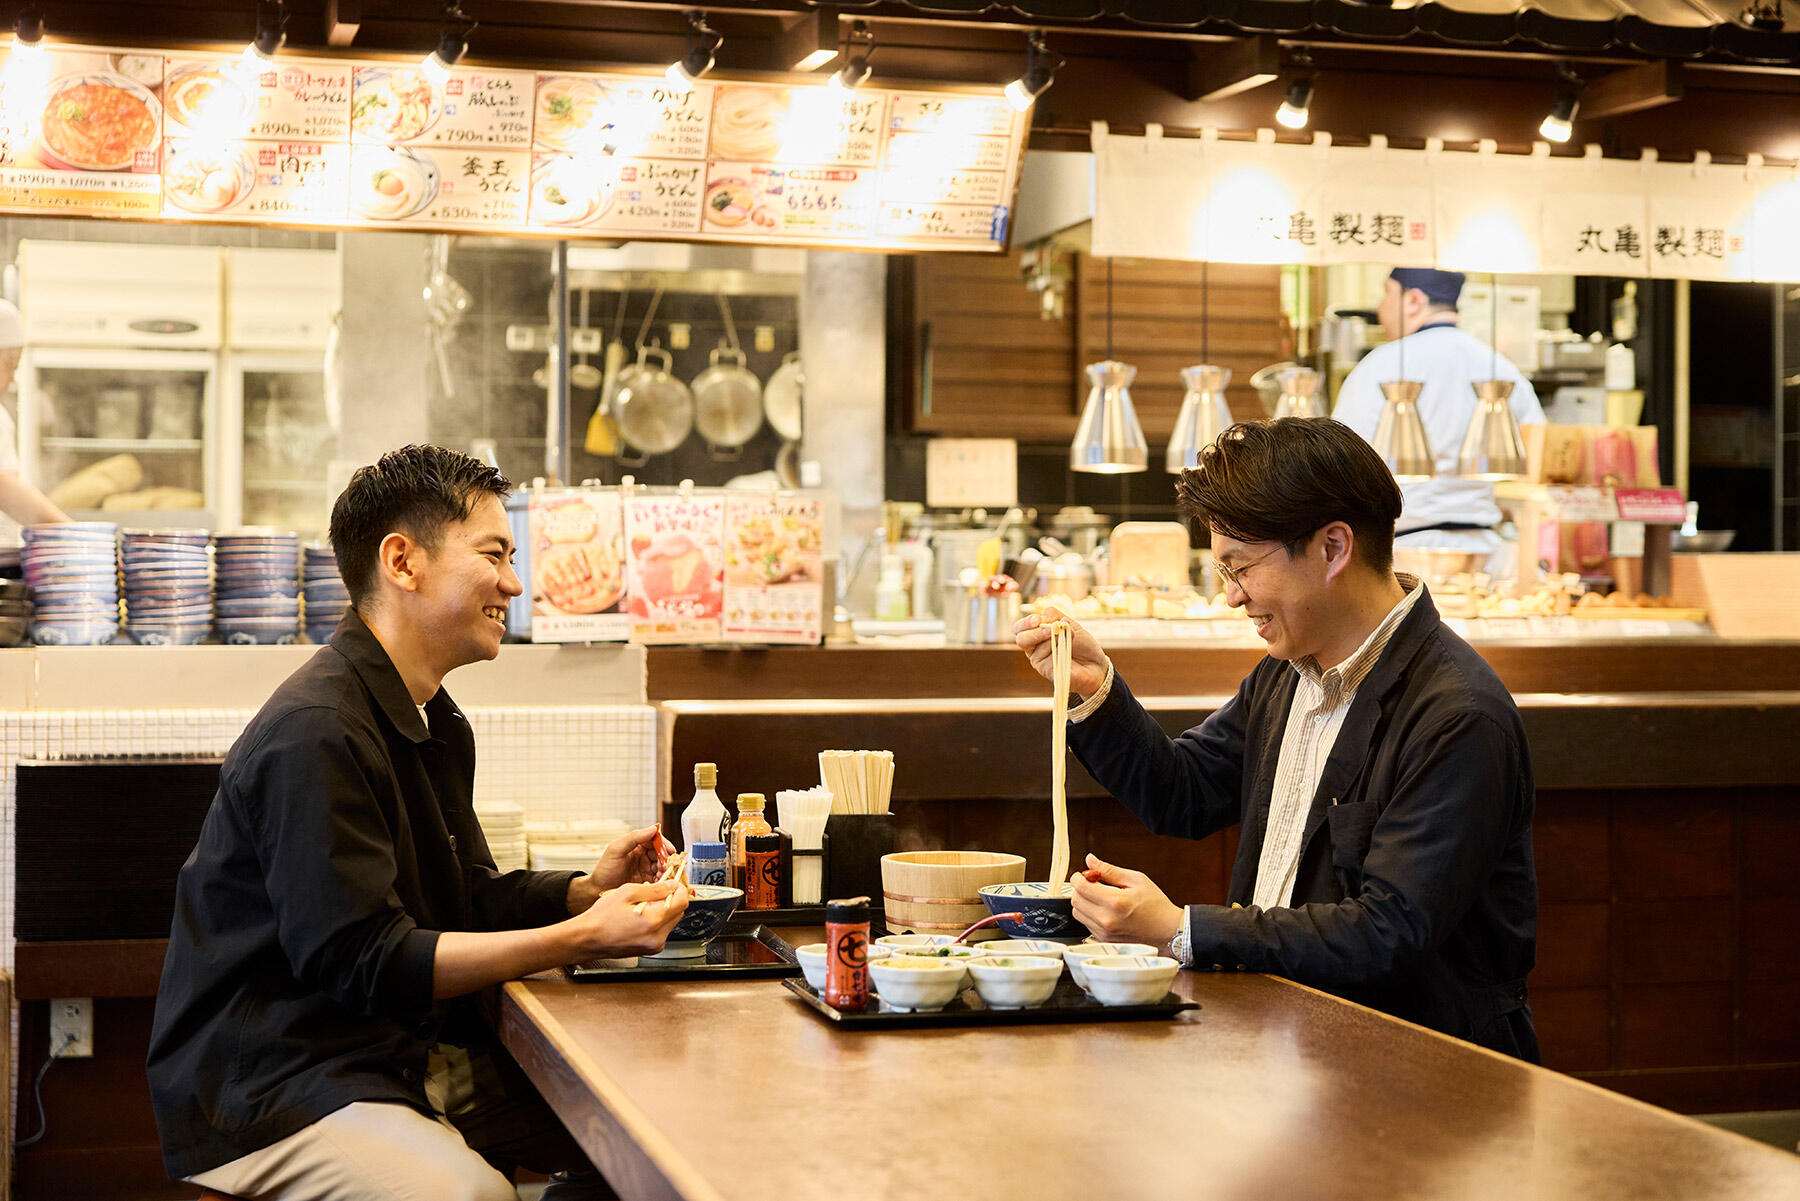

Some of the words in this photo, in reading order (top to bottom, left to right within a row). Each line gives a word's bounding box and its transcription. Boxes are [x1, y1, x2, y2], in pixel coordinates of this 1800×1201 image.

[662, 106, 704, 122] うどん
[261, 123, 300, 136] 890円
[446, 130, 484, 142] 790円
[479, 178, 521, 192] うどん
[655, 182, 697, 198] うどん
[1256, 210, 1405, 246] 亀製麺
[1576, 224, 1726, 258] 丸亀製麺
